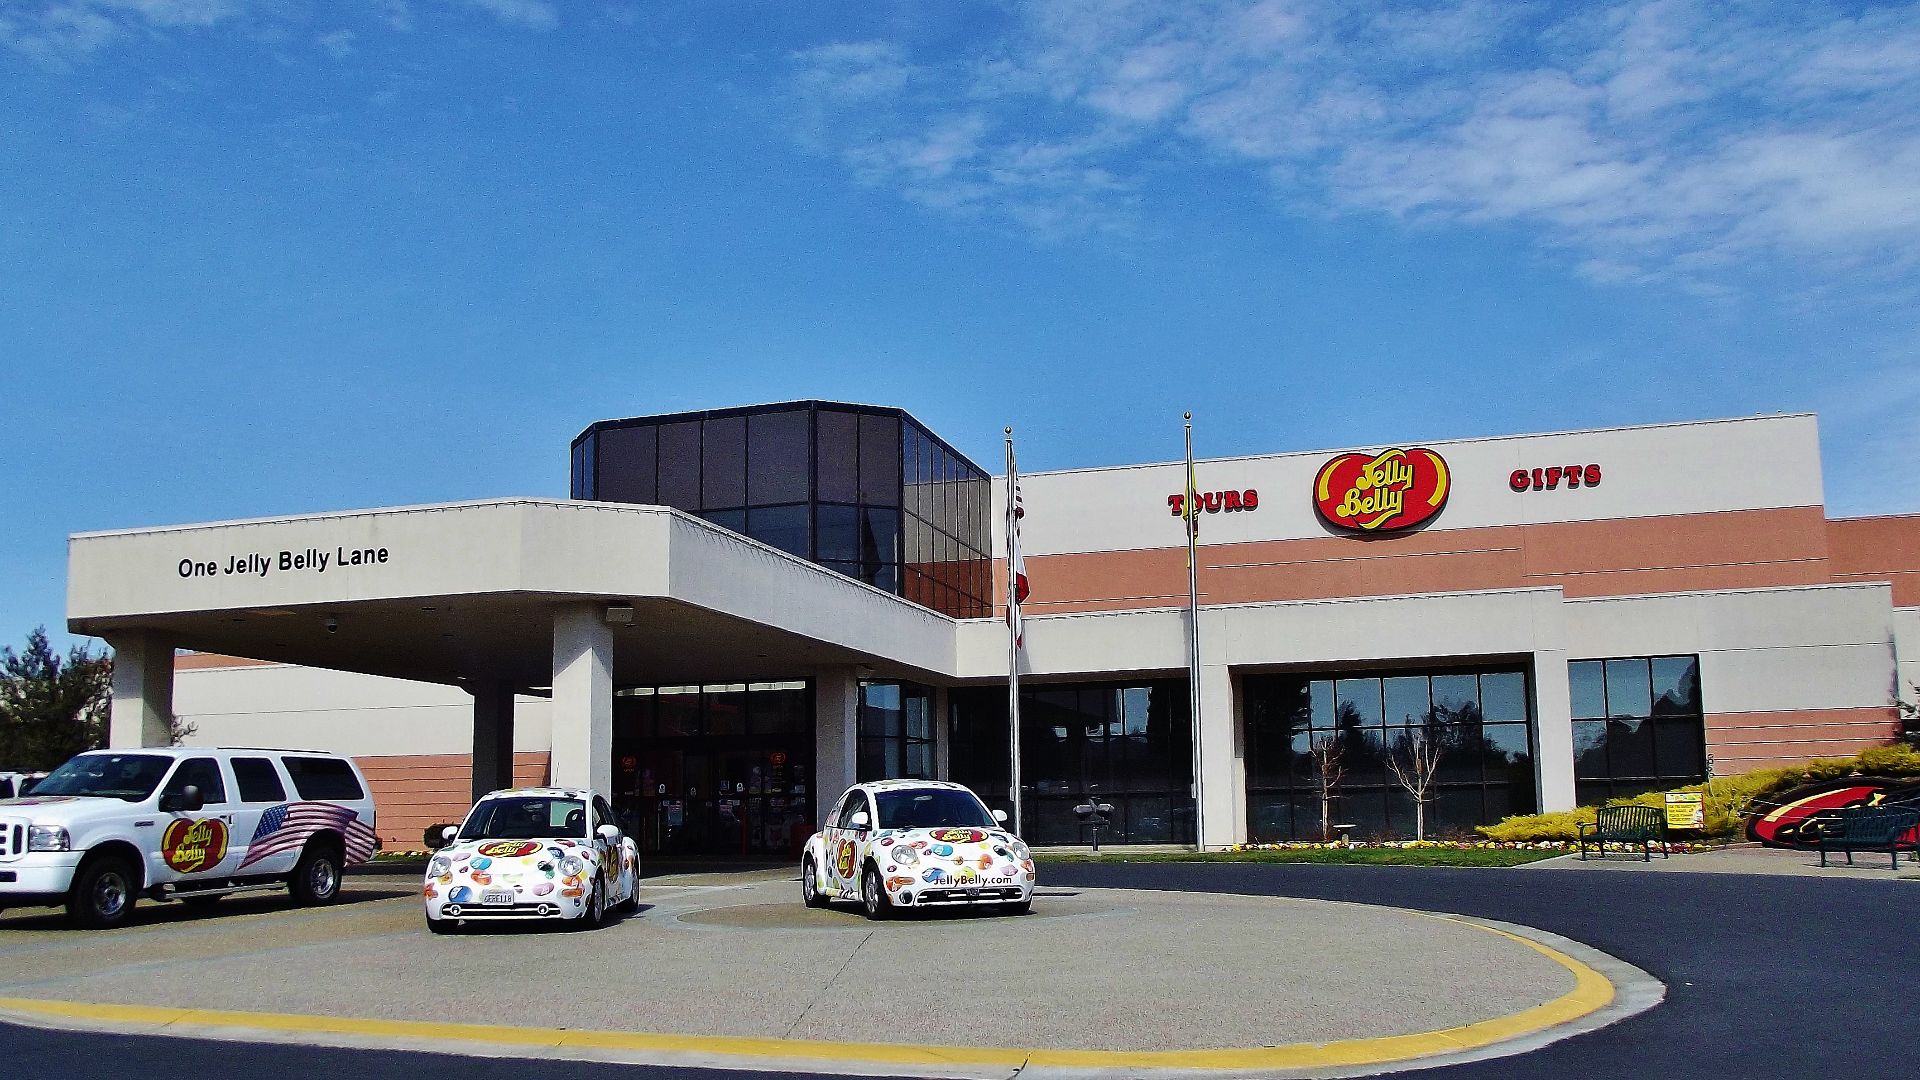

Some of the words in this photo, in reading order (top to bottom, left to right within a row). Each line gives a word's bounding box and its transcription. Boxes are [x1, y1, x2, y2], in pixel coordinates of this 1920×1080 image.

[1356, 450, 1413, 490] Jelly
[1509, 464, 1601, 492] GIFTS
[1336, 487, 1403, 529] Belly
[178, 558, 217, 577] One
[224, 553, 271, 577] Jelly
[278, 548, 330, 572] Belly
[337, 546, 389, 566] Lane
[183, 818, 212, 846] Jelly
[934, 874, 1012, 887] JellyBelly.com
